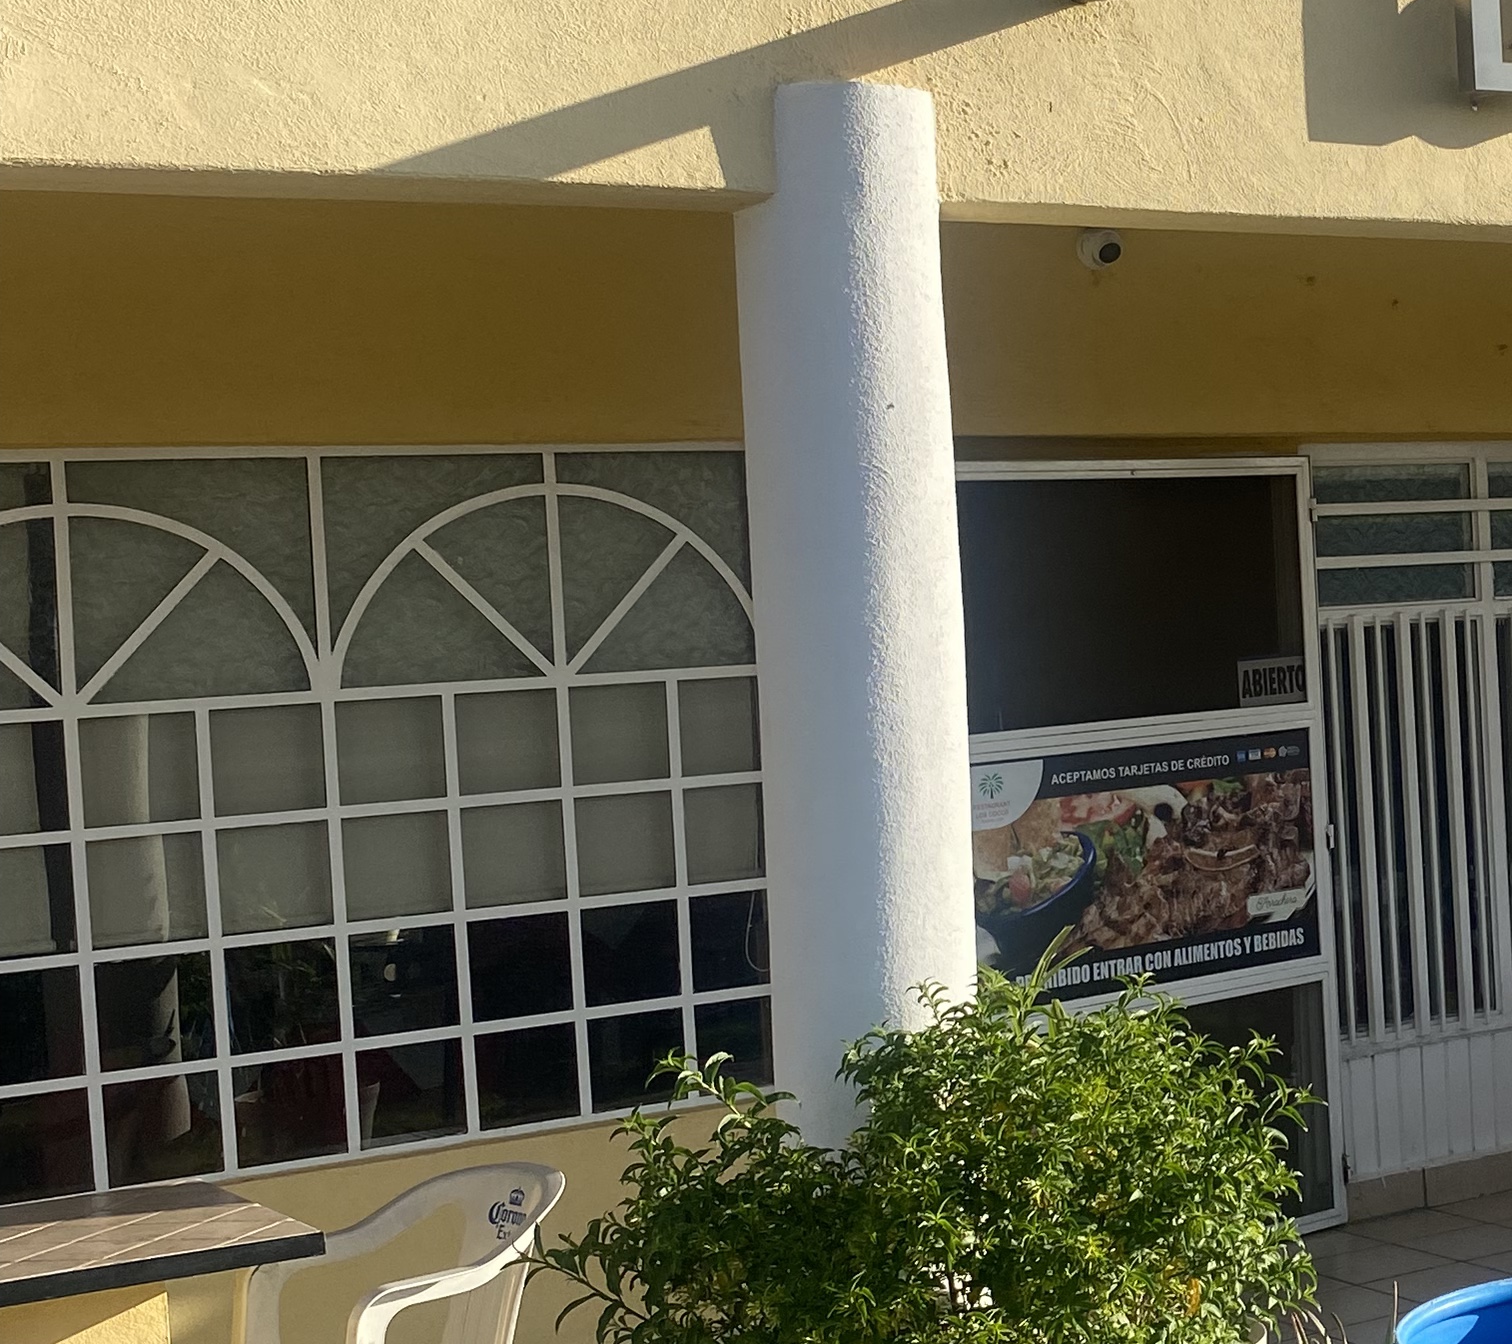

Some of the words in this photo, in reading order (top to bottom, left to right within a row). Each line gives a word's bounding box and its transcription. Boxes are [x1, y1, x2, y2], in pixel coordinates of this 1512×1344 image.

[1242, 664, 1306, 699] ABIERTO
[1051, 767, 1116, 785] ACEPTAMOS
[1118, 761, 1169, 777] TARJETAS
[1170, 759, 1185, 772] DE
[1186, 754, 1230, 770] CRÉDITO
[1015, 964, 1091, 990] PRHIBIDO
[1093, 955, 1143, 981] ENTRAR
[1145, 949, 1172, 972] CON
[1173, 938, 1242, 967] ALIMENTOS
[1243, 935, 1252, 954] Y
[1253, 927, 1305, 953] BEBIDAS
